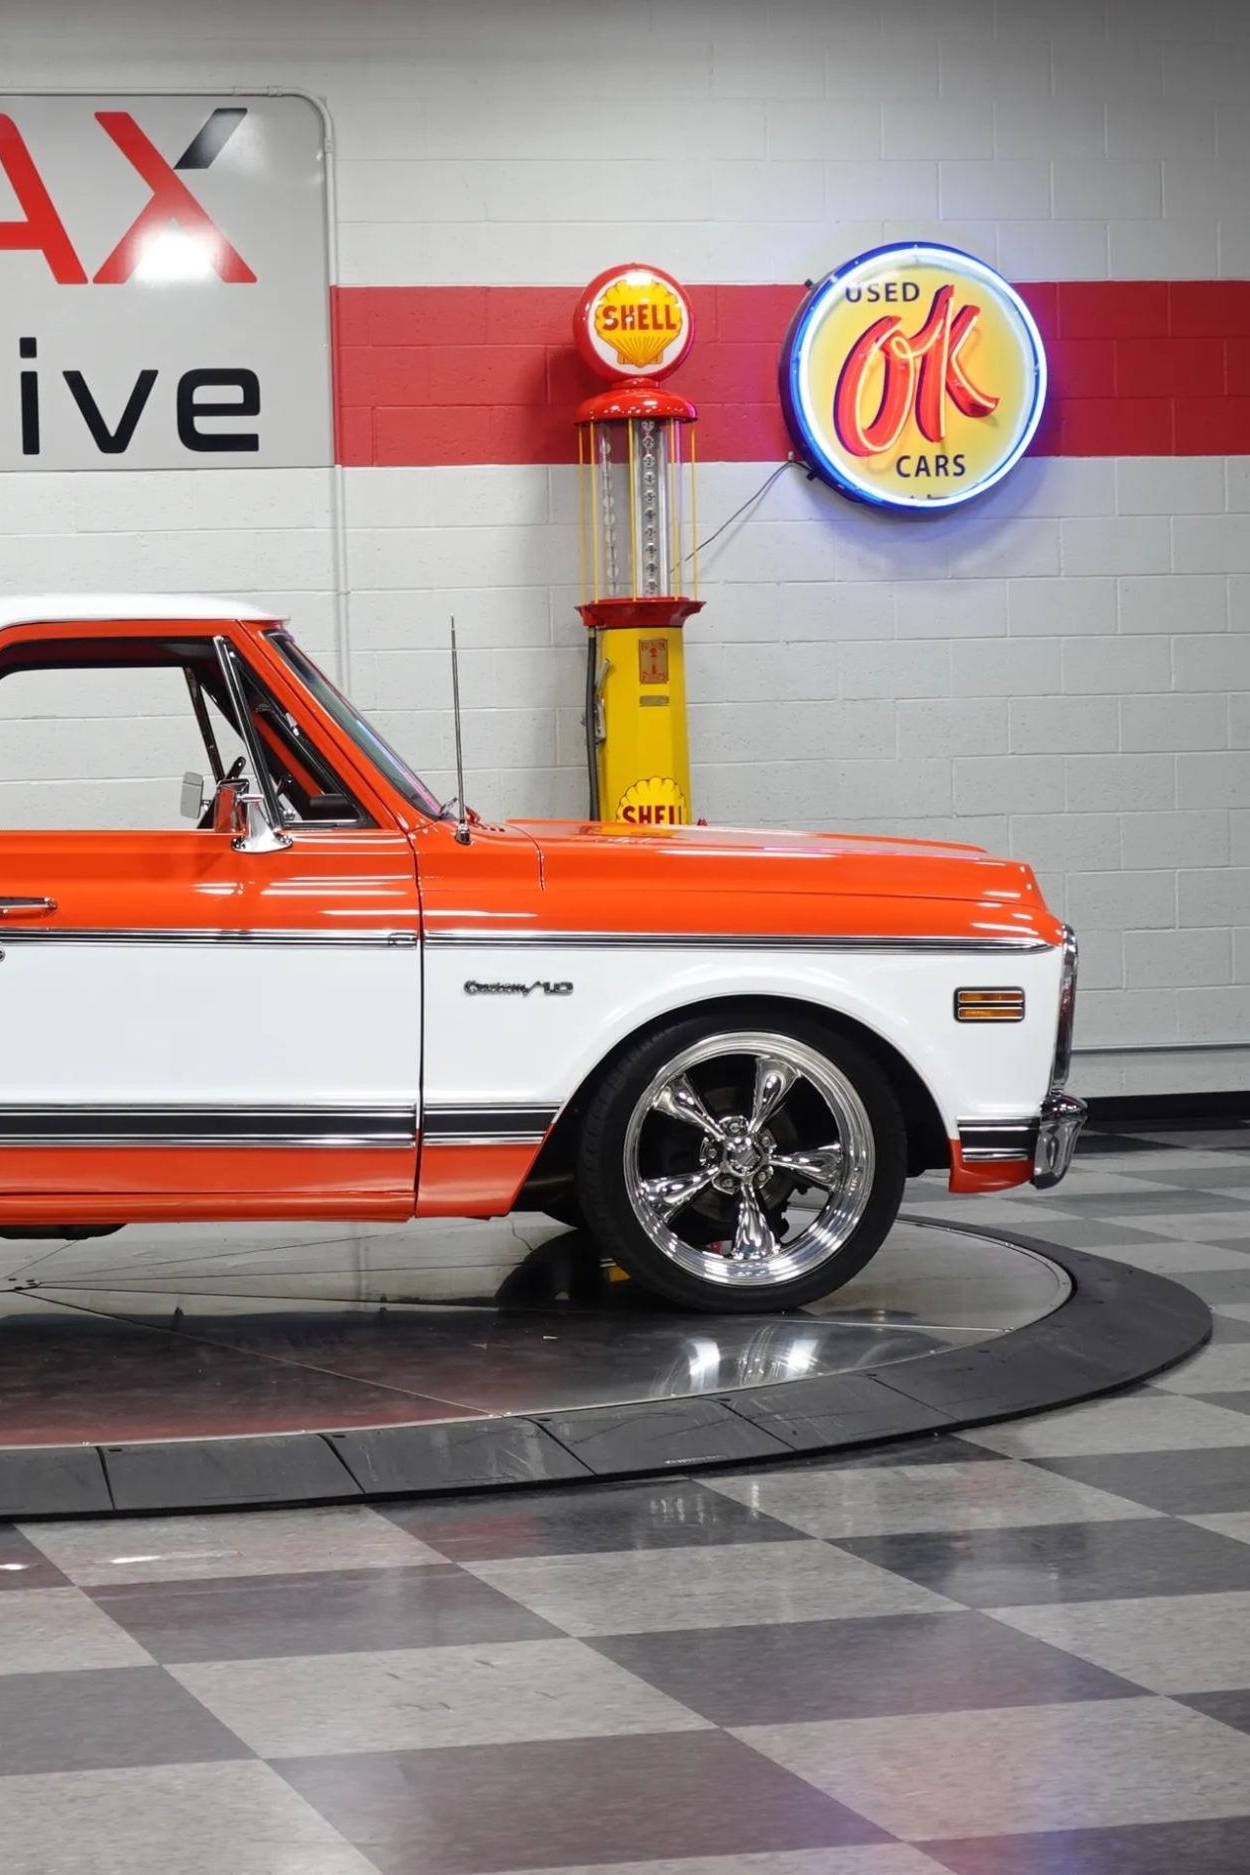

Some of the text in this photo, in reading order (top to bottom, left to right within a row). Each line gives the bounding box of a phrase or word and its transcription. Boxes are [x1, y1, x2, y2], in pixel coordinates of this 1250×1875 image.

[845, 282, 921, 303] USED
[602, 304, 678, 331] SHELL
[833, 284, 1000, 457] OK
[896, 454, 966, 478] CARS
